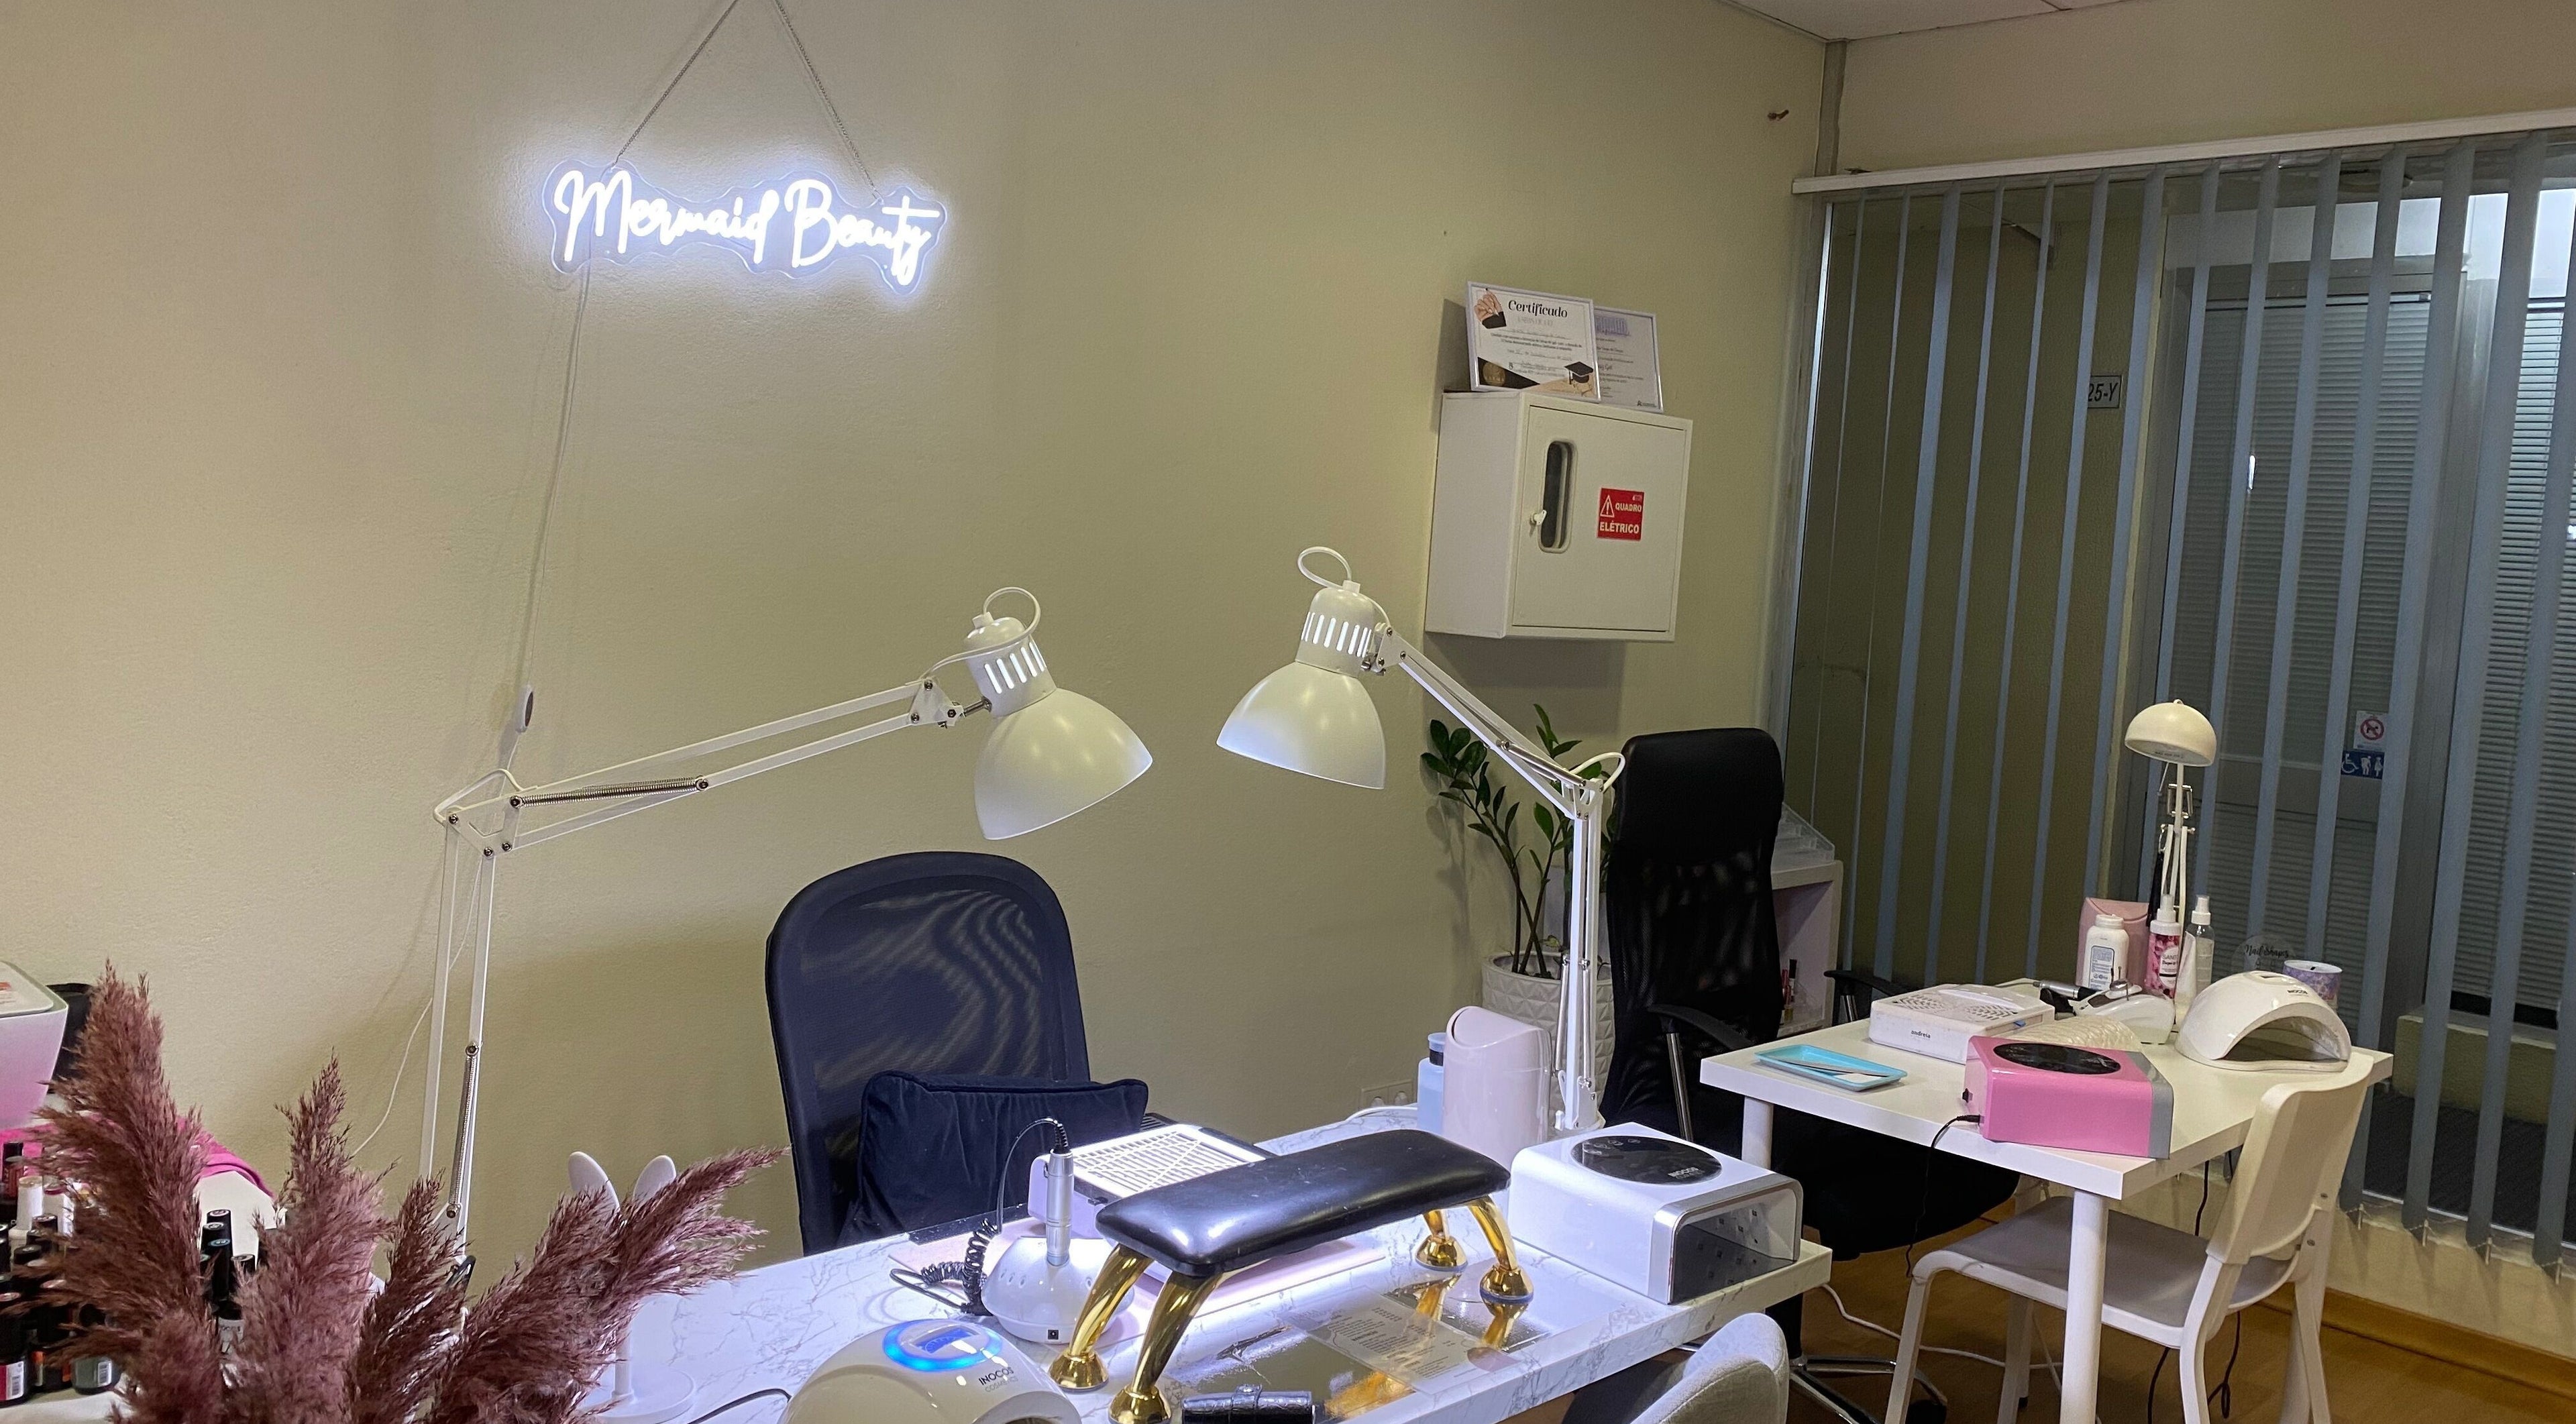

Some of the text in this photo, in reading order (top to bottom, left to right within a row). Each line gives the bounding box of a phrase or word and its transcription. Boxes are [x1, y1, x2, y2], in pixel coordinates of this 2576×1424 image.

[553, 169, 941, 286] Mermaid Beauty
[1508, 300, 1568, 318] Certificado
[1615, 502, 1642, 513] QUADRO
[1599, 521, 1640, 534] ELÉTRICO
[978, 1366, 1014, 1386] INOCOS
